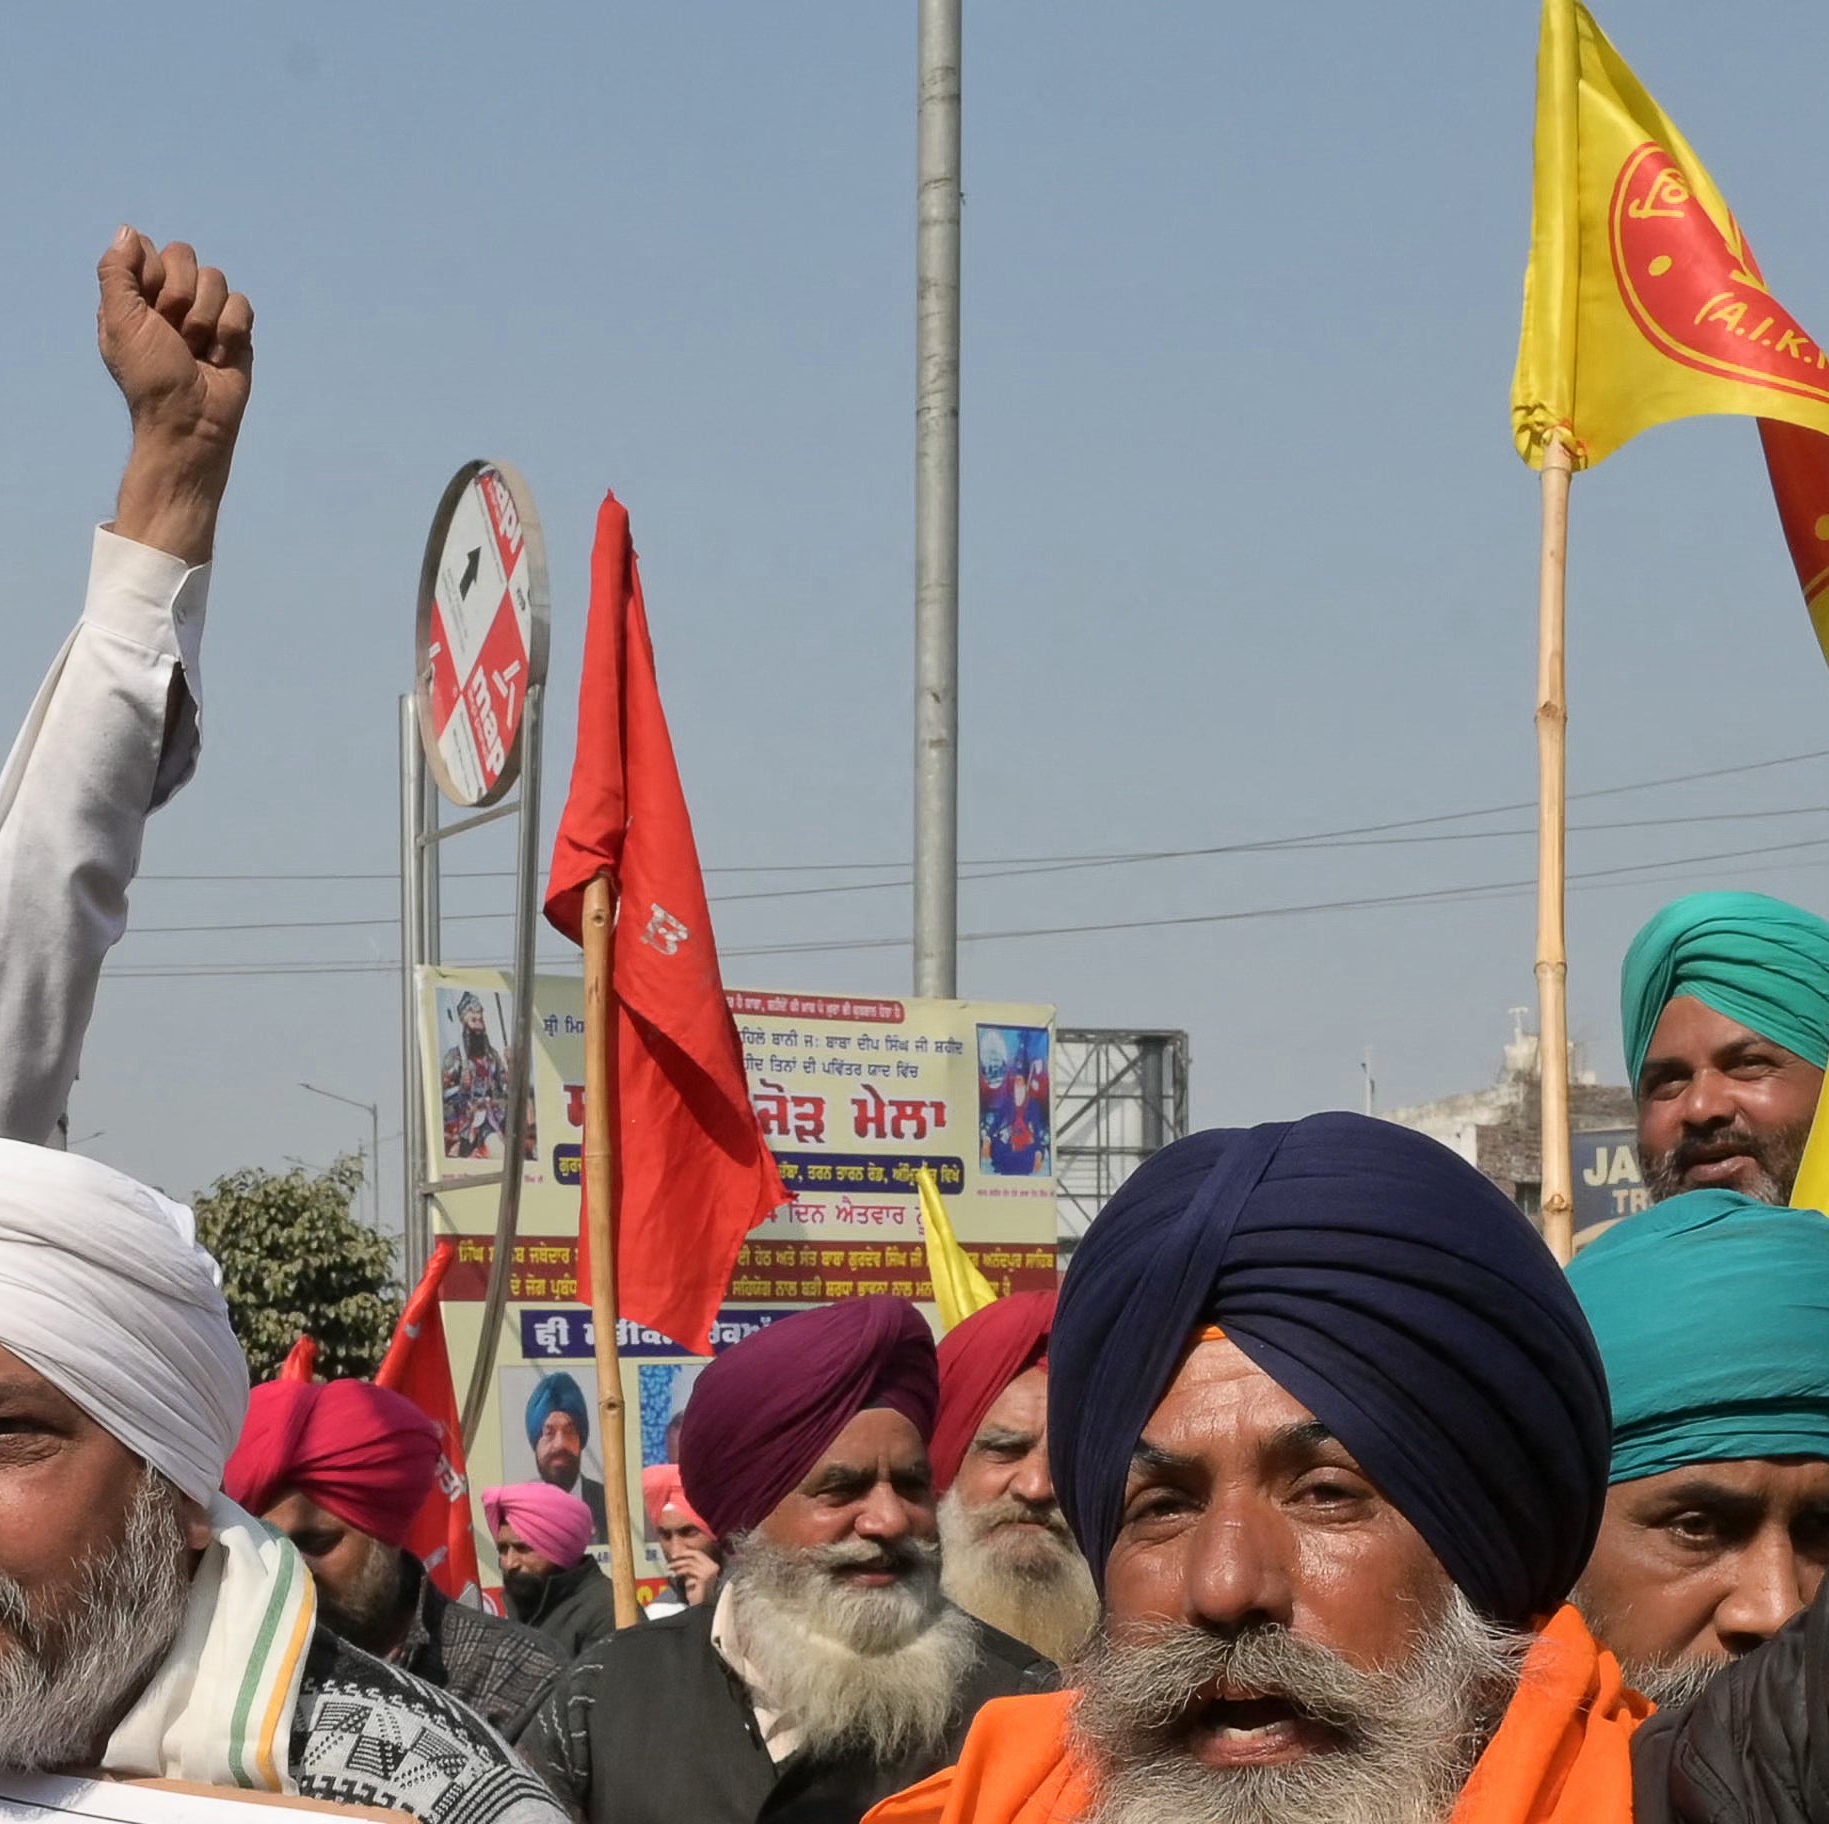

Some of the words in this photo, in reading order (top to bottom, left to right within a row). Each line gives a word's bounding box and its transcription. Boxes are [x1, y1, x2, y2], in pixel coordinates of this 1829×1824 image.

[752, 1078, 826, 1143] ਜੋੜ
[851, 1083, 947, 1140] ਮੇਲਾ
[836, 1196, 906, 1225] ਐਤਵਾਰ
